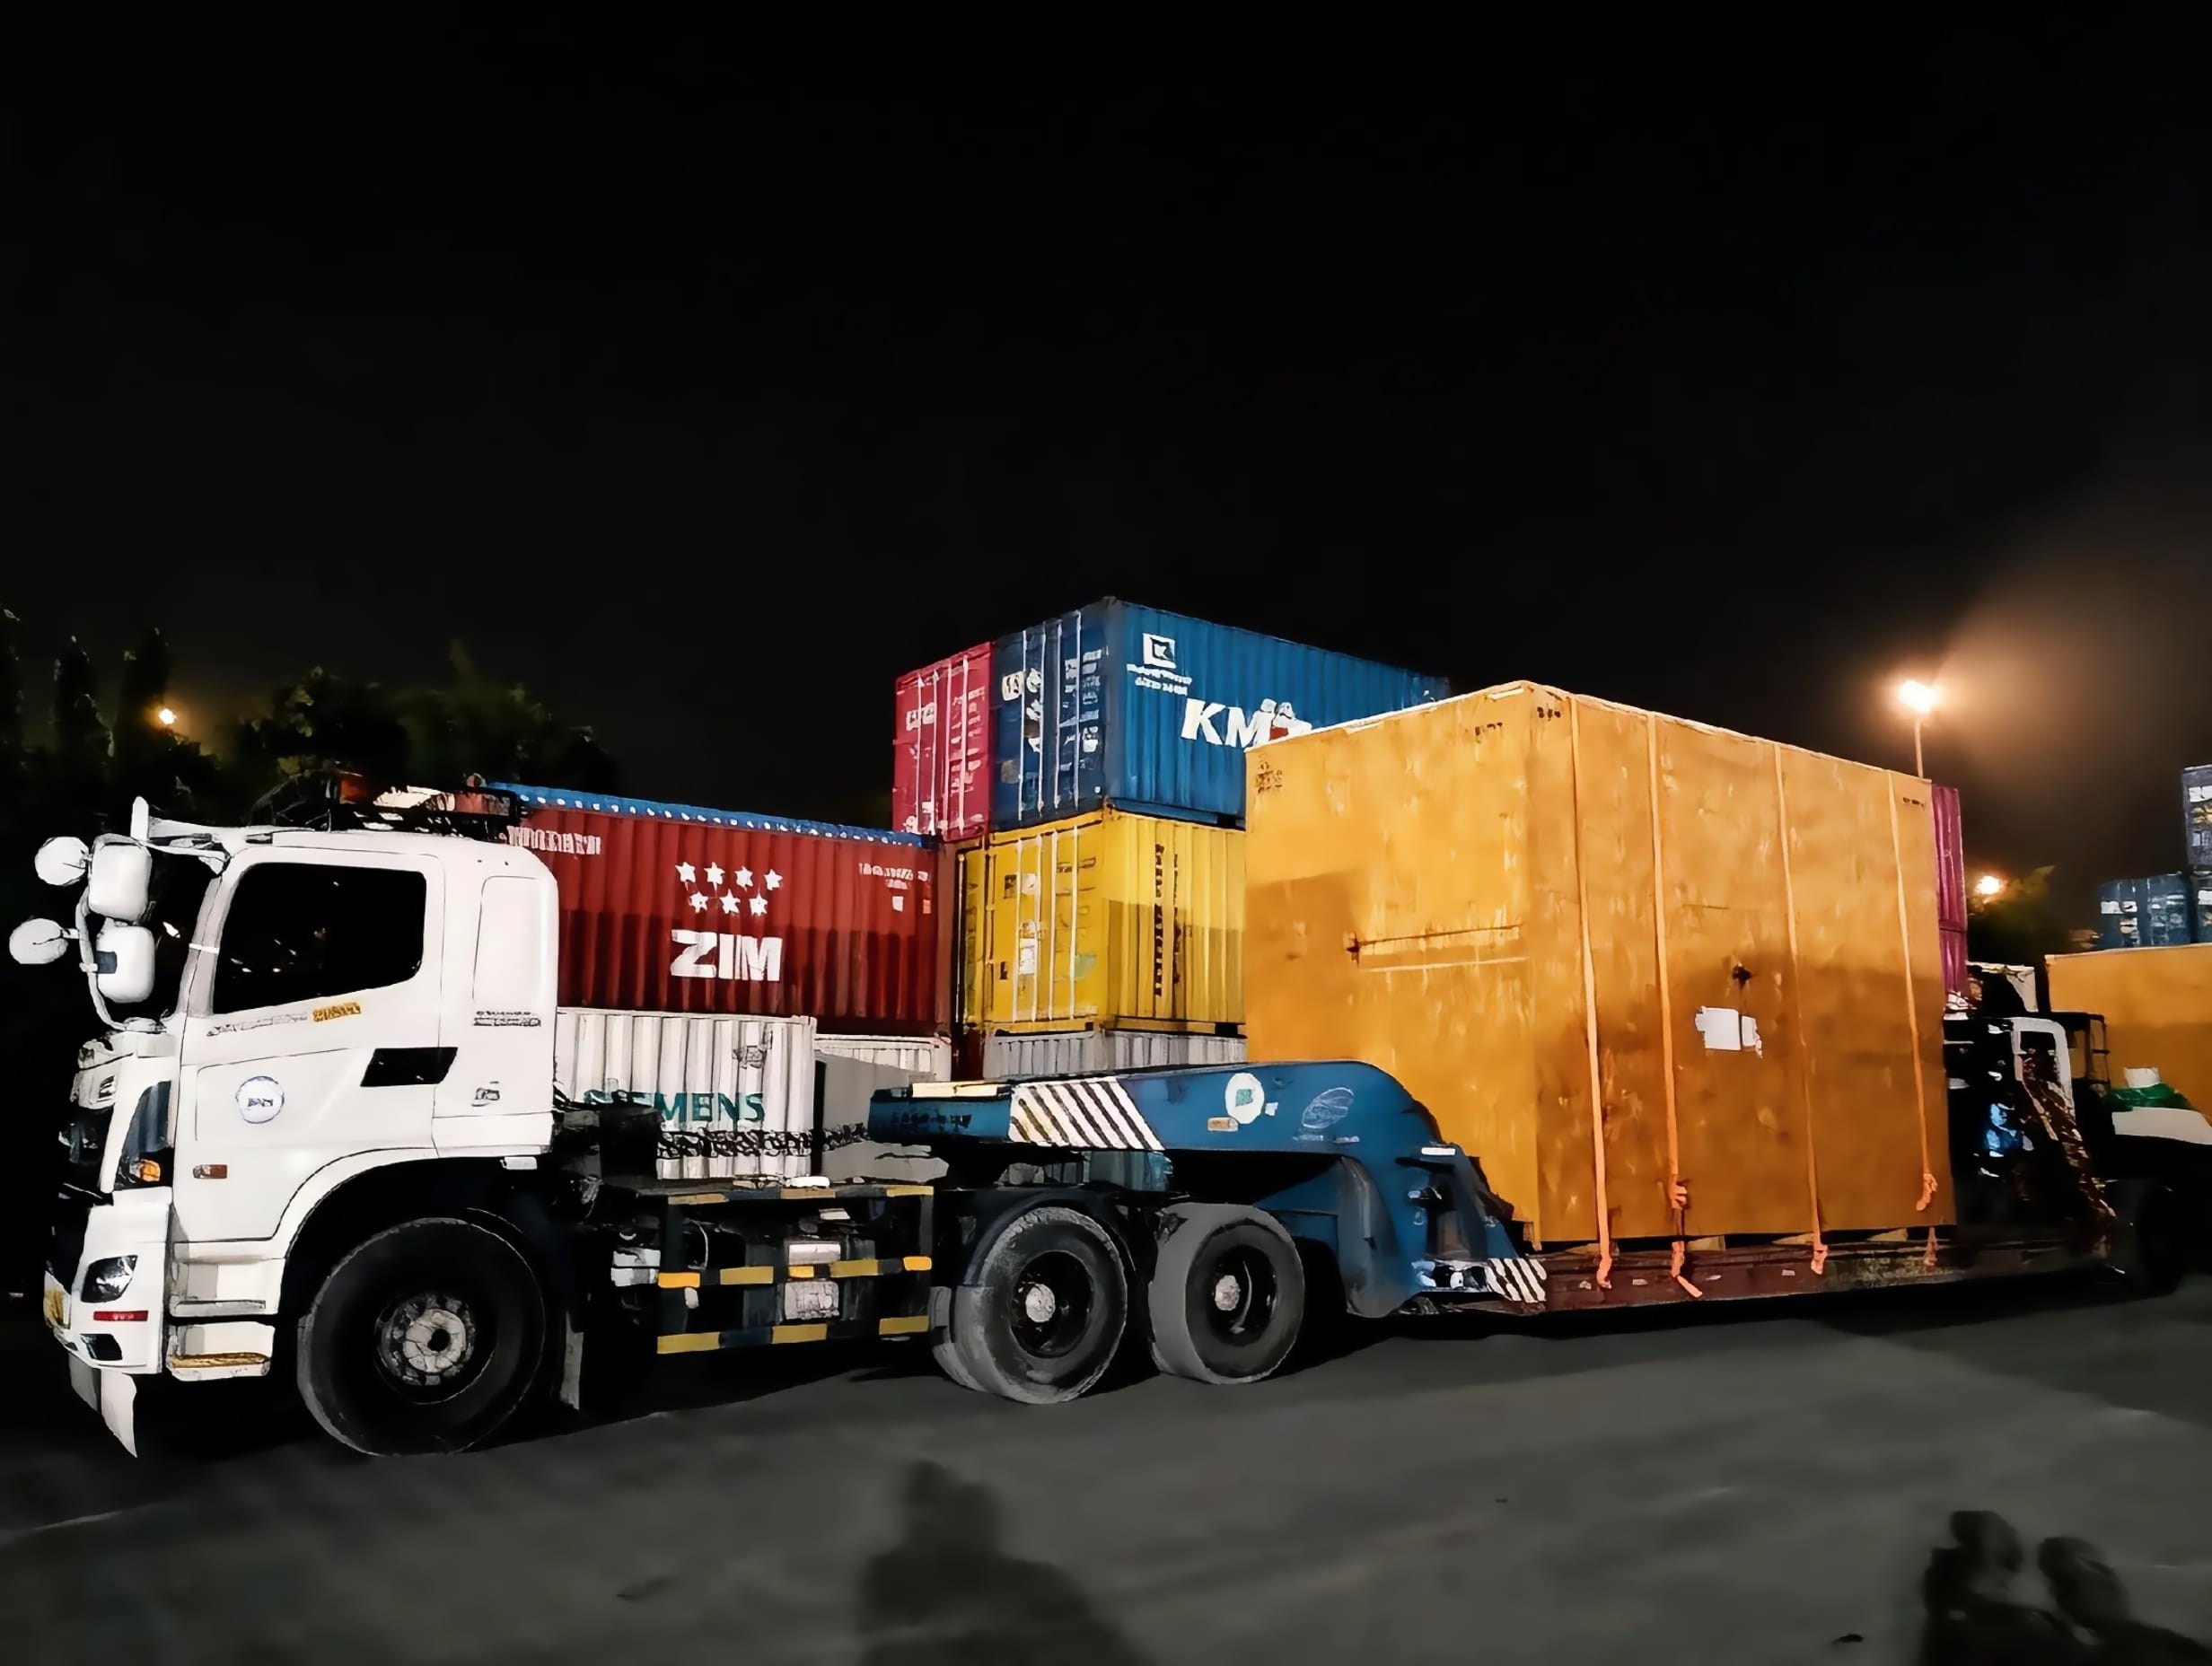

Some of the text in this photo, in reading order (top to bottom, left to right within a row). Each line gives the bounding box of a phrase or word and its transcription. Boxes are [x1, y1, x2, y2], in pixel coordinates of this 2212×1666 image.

[1181, 698, 1312, 748] KM
[670, 929, 783, 981] ZIM
[584, 1090, 766, 1123] MENS
